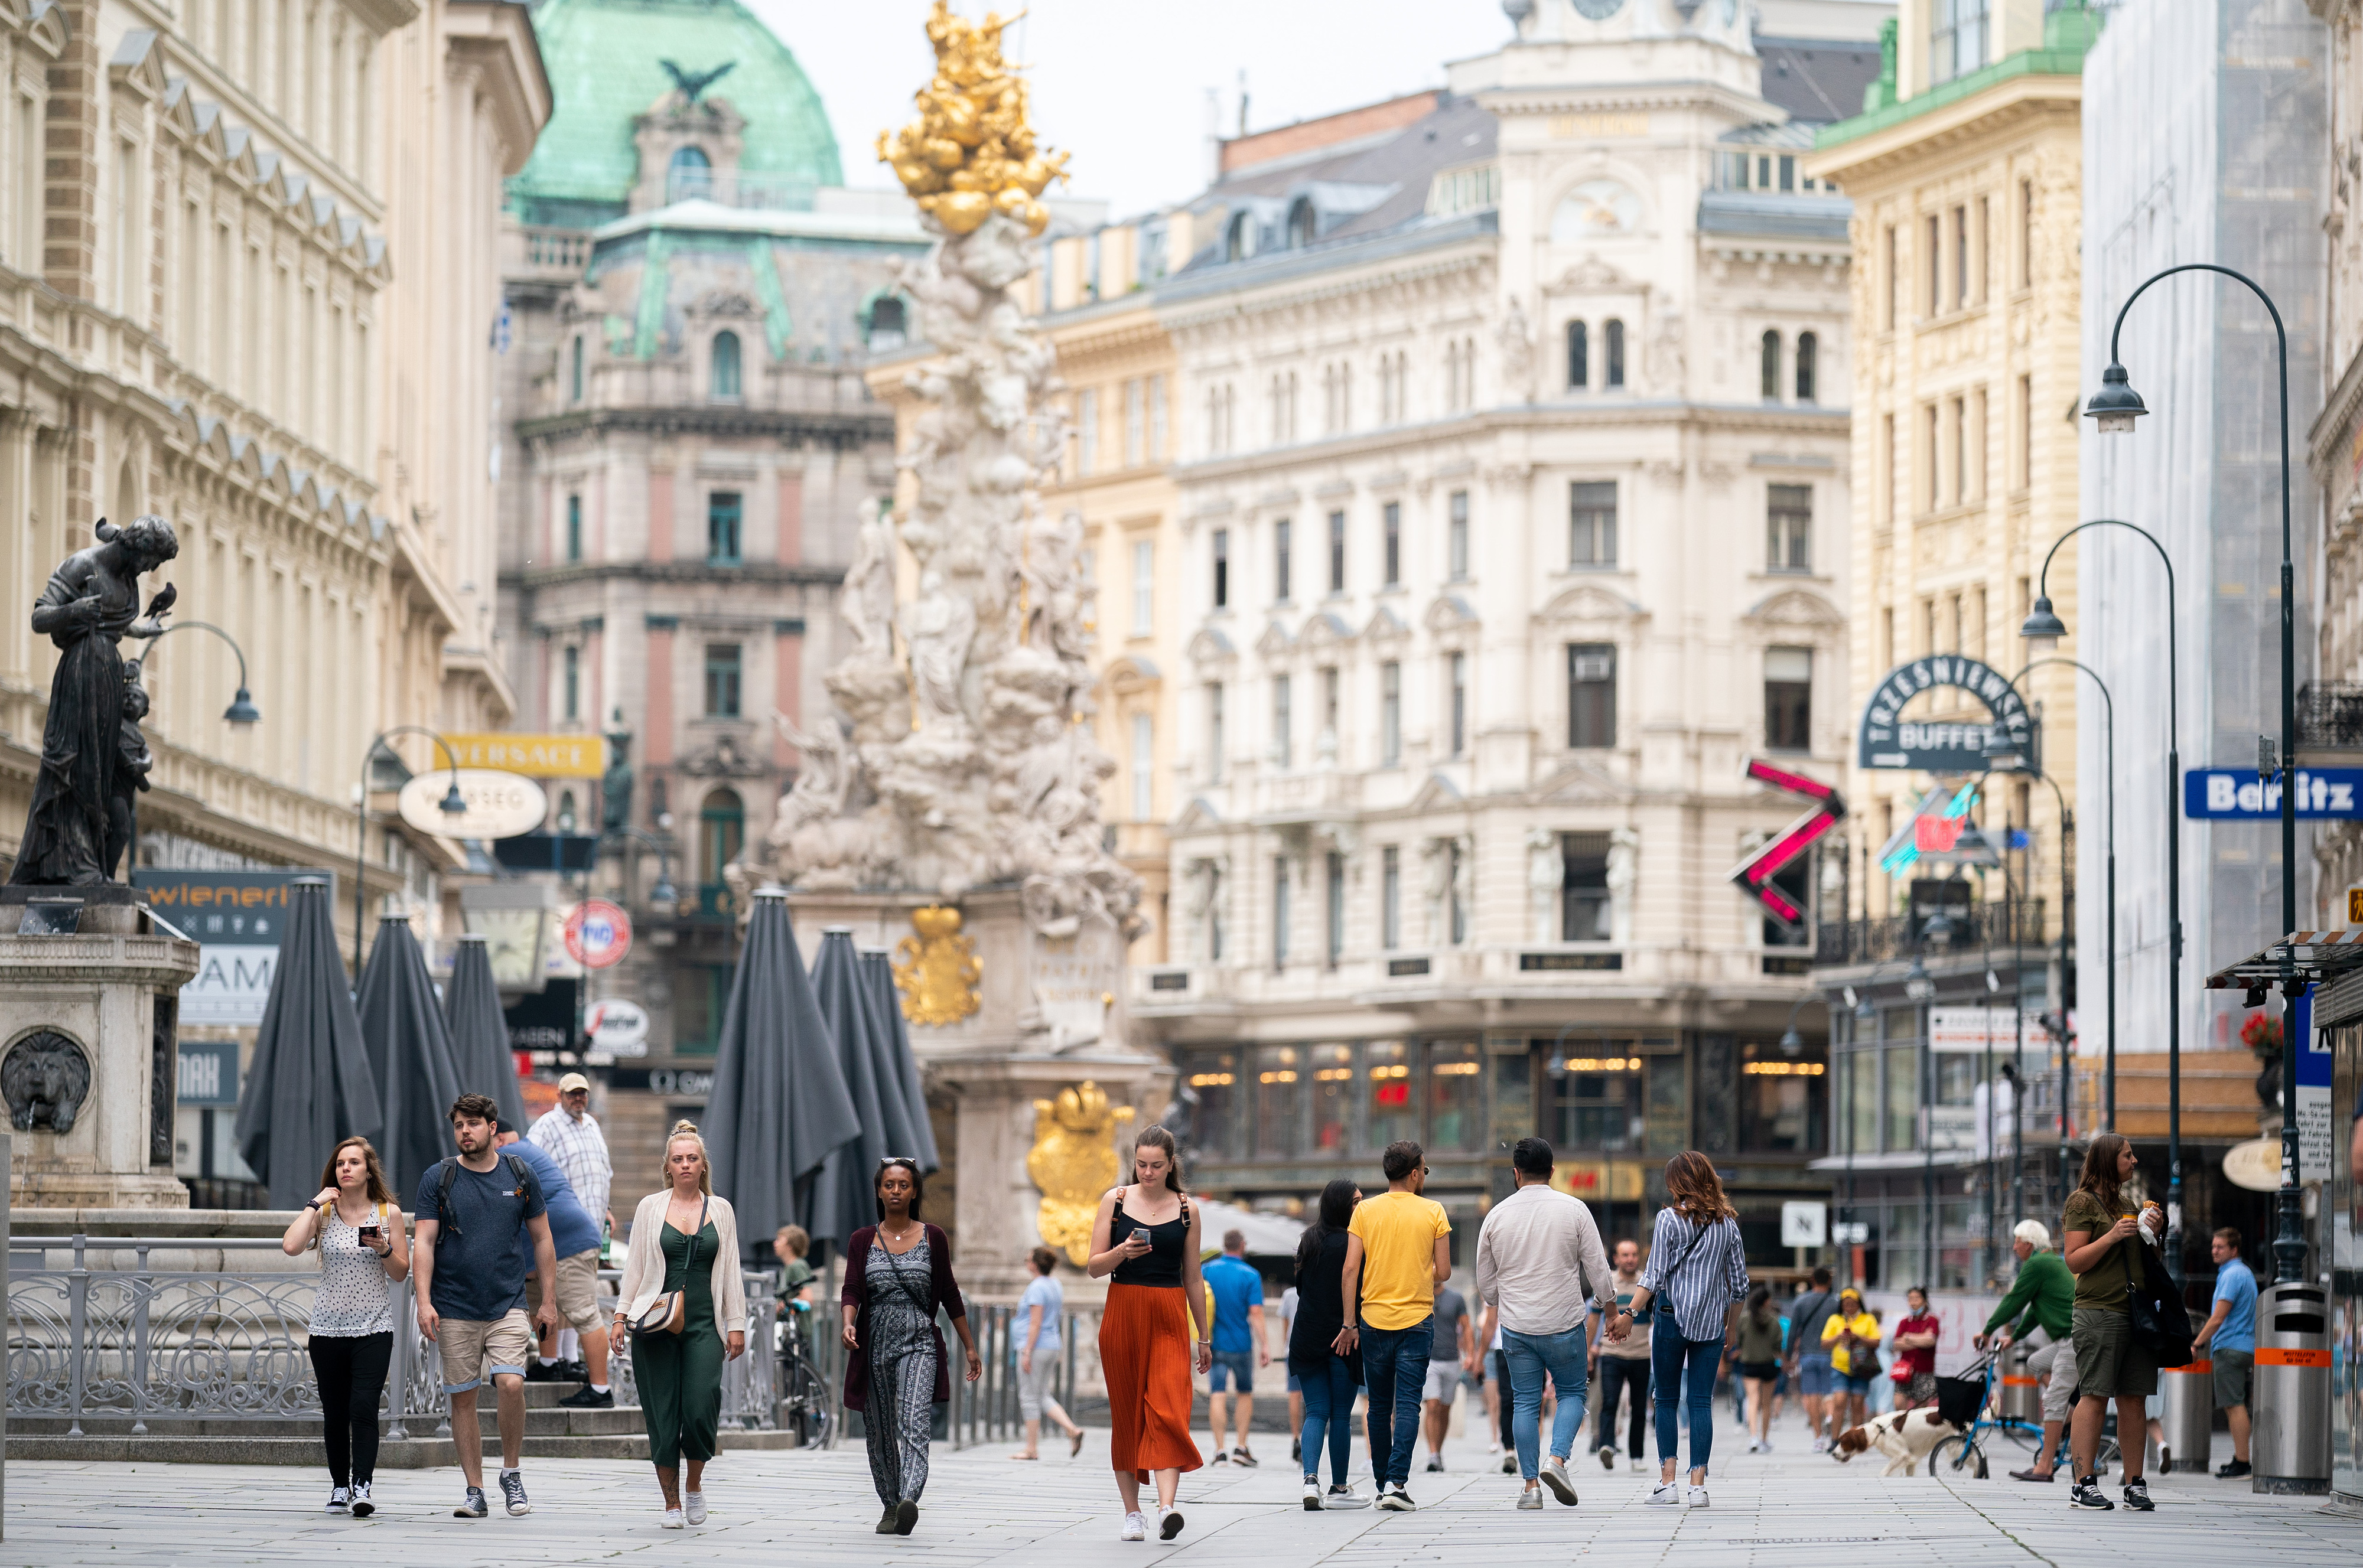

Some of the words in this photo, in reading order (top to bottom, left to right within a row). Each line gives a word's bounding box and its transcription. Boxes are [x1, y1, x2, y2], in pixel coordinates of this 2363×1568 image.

[450, 742, 582, 767] VERSACE
[2206, 771, 2354, 813] Beritz
[184, 955, 270, 993] AM
